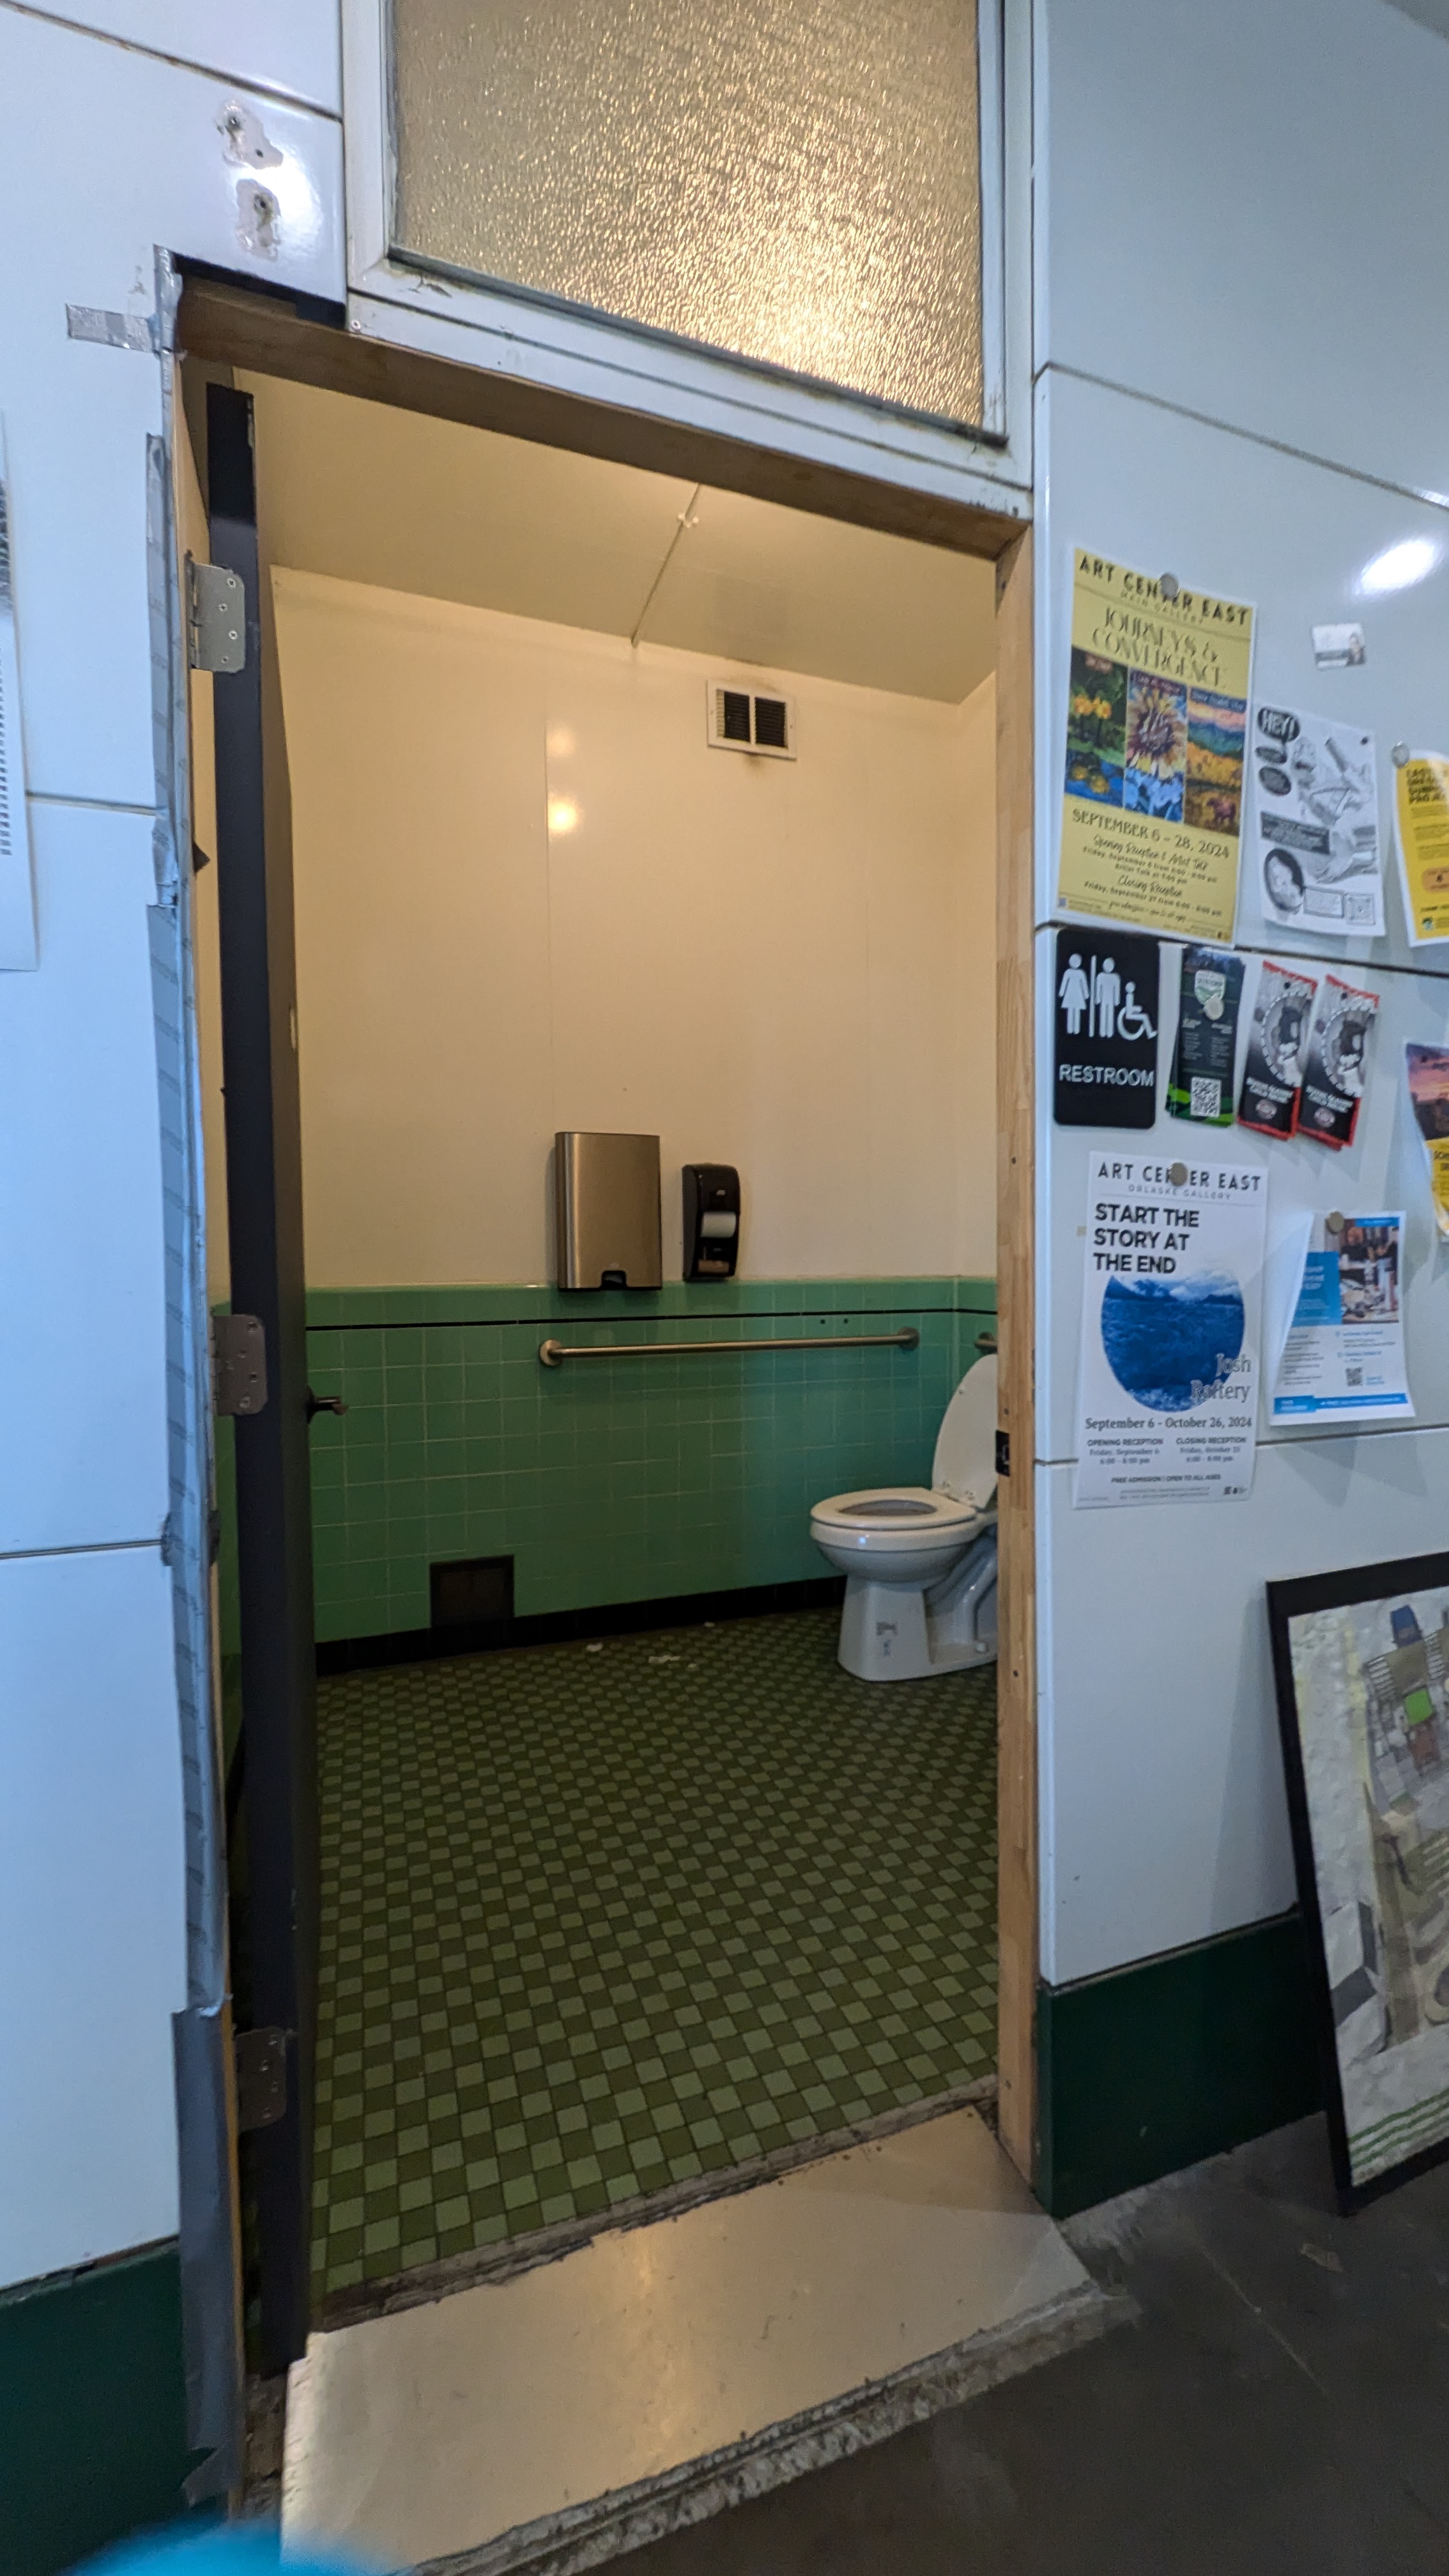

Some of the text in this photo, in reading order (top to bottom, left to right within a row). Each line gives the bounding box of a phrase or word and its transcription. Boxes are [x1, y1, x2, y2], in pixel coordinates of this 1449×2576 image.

[1080, 555, 1248, 625] ART CENER EAST
[1105, 608, 1217, 663] JOURNEYS &
[1092, 629, 1227, 688] CONVERGENCE
[1073, 808, 1148, 839] SEPTEMBER
[1151, 829, 1160, 842] 6
[1175, 834, 1193, 852] 28,
[1198, 839, 1229, 859] 2024
[1059, 1064, 1155, 1087] RESTROOM
[1098, 1162, 1261, 1191] ART CEER EAST
[1183, 1190, 1231, 1200] GALLERY
[1094, 1202, 1200, 1228] START THE
[1093, 1227, 1190, 1251] STORY AT
[1093, 1252, 1176, 1275] THE END
[1216, 1353, 1251, 1377] Josh
[1190, 1379, 1251, 1403] Raftery
[1085, 1417, 1145, 1431] September
[1147, 1418, 1155, 1428] 6
[1165, 1417, 1207, 1428] October
[1209, 1416, 1225, 1429] 26,
[1228, 1416, 1252, 1428] 2024
